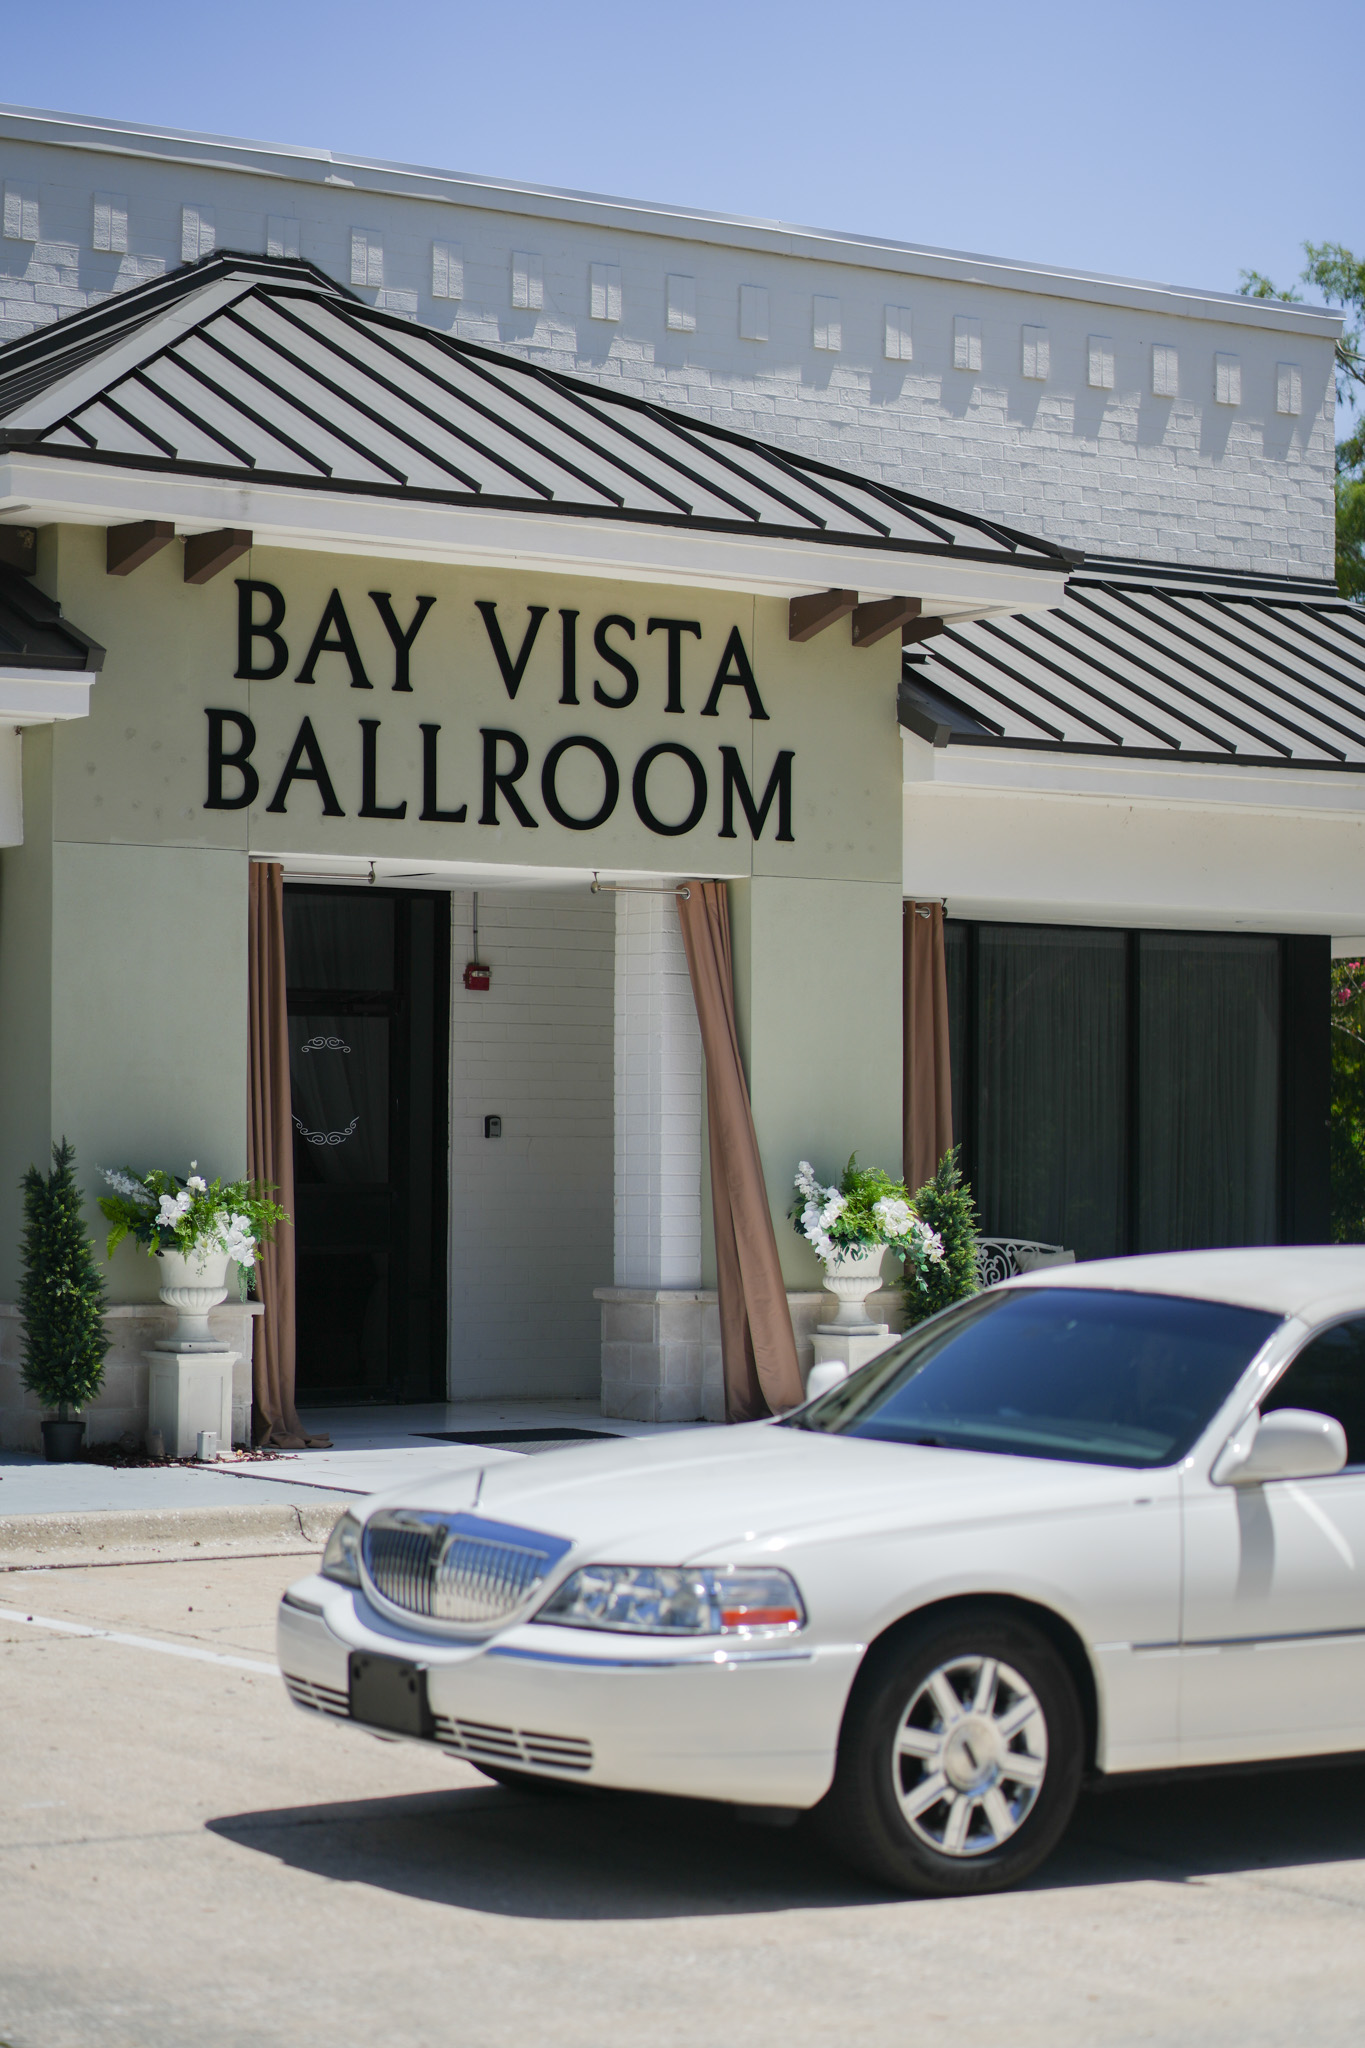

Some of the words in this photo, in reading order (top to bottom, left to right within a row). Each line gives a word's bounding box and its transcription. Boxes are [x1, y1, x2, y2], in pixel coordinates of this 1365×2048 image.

[233, 577, 438, 693] BAY
[473, 600, 771, 721] VISTA
[202, 707, 797, 842] BALLROOM
